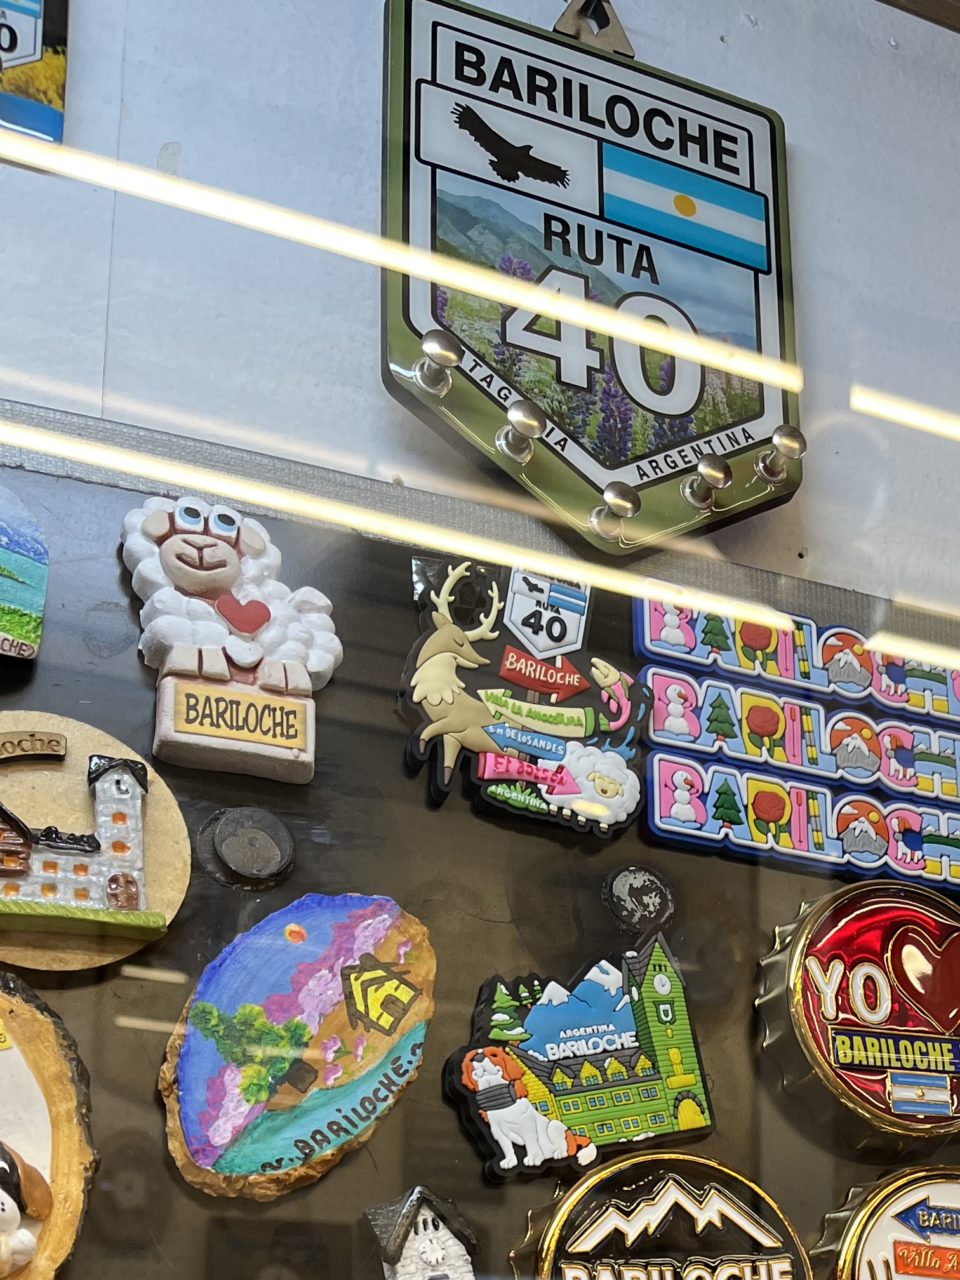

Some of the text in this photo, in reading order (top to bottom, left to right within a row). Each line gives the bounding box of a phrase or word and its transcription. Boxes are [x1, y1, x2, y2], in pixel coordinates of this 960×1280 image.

[454, 40, 742, 176] BARILOCHE
[542, 211, 661, 286] RUTA
[500, 264, 706, 418] 40
[635, 427, 756, 482] ARGENTINA
[521, 609, 568, 643] 40
[535, 600, 562, 616] RUTA
[504, 651, 581, 686] BARILOCHE
[184, 692, 299, 741] BARILOCHE
[532, 739, 565, 755] ANDES
[805, 955, 893, 1025] YO
[545, 1031, 640, 1062] BARILOCHE
[559, 1023, 616, 1039] ARGENTINA
[836, 1034, 956, 1072] BARILOCHE
